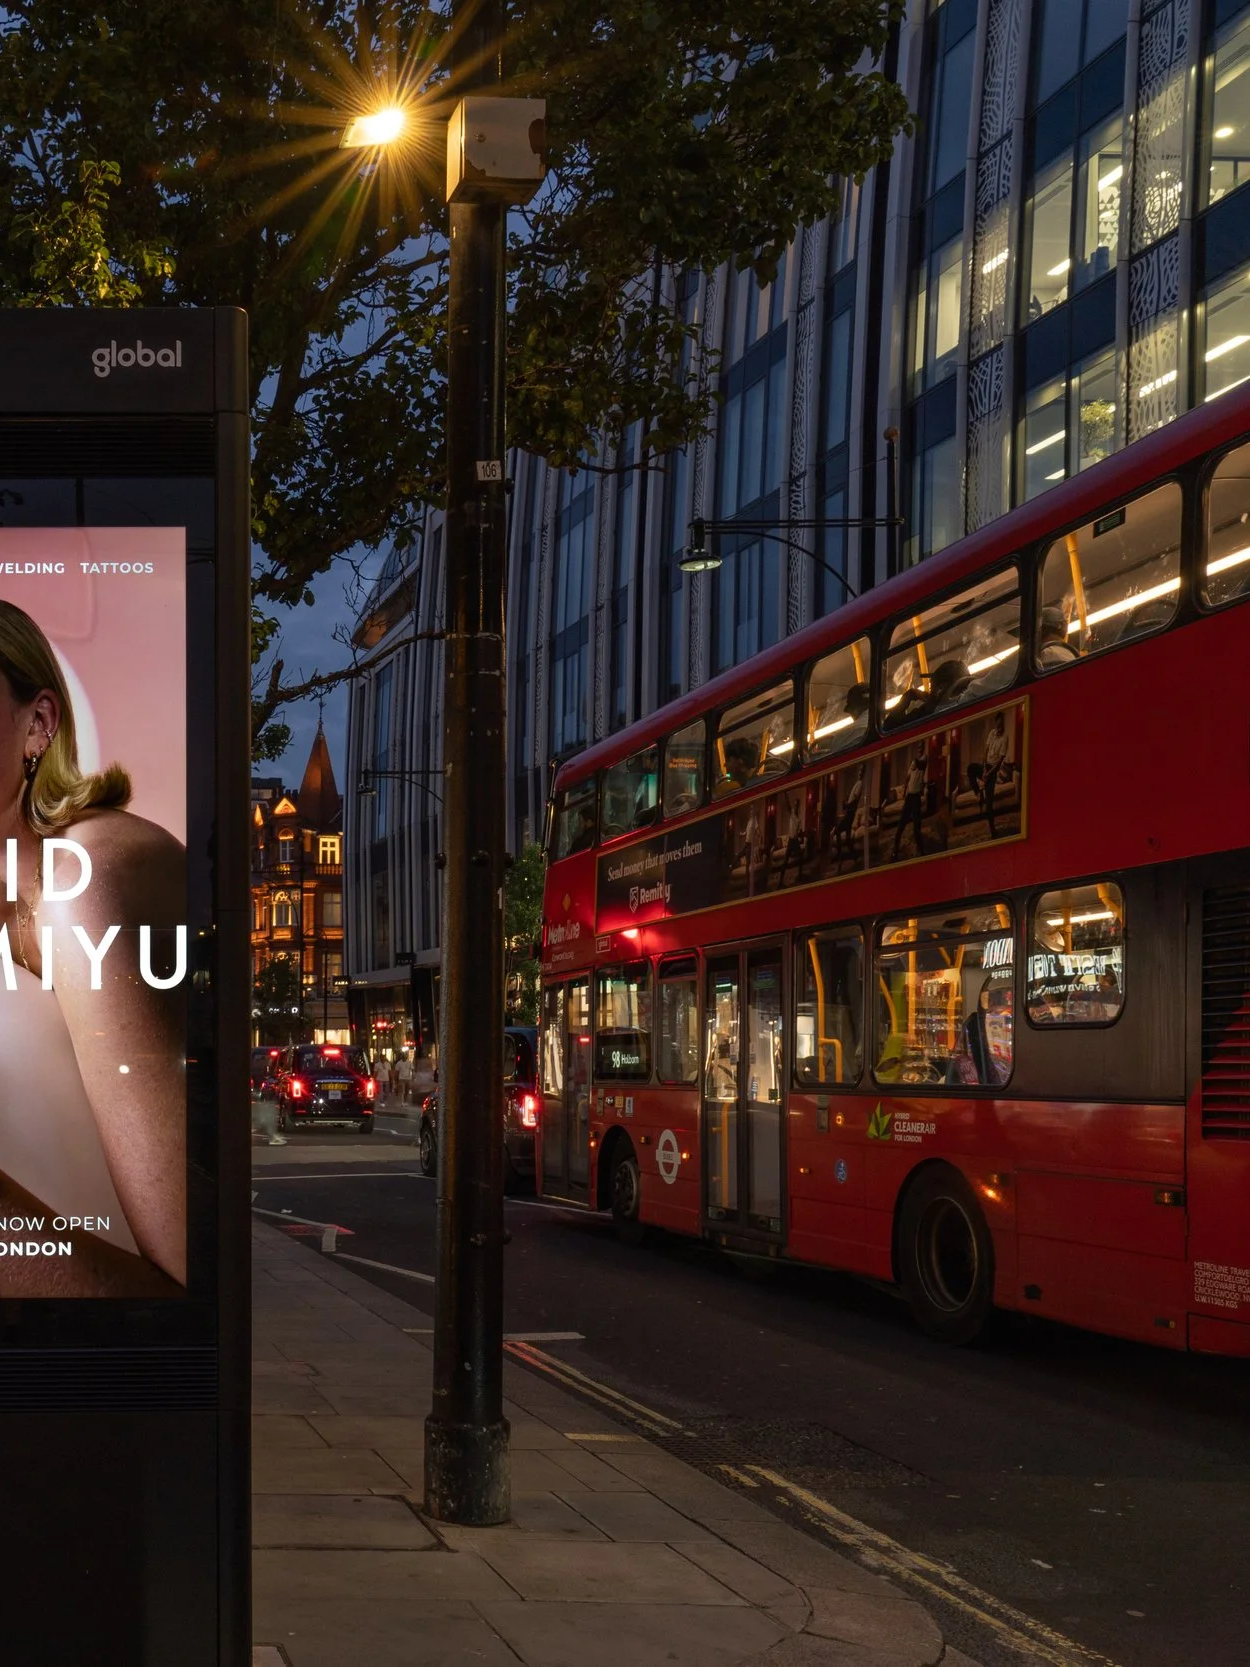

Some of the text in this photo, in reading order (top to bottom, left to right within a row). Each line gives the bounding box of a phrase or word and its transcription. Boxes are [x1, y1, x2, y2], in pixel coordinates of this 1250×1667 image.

[91, 340, 182, 378] global
[481, 463, 497, 478] 106
[80, 561, 154, 574] TATTOOS
[607, 840, 703, 882] Send money that moves them
[611, 1050, 639, 1068] 98 Holborn
[894, 1134, 922, 1144] FOR LONDON
[56, 1216, 111, 1231] OPEN
[1193, 1261, 1229, 1274] METROLINE
[1193, 1269, 1250, 1286] COMFORTDELGRO
[1206, 1279, 1237, 1292] EDGWARE
